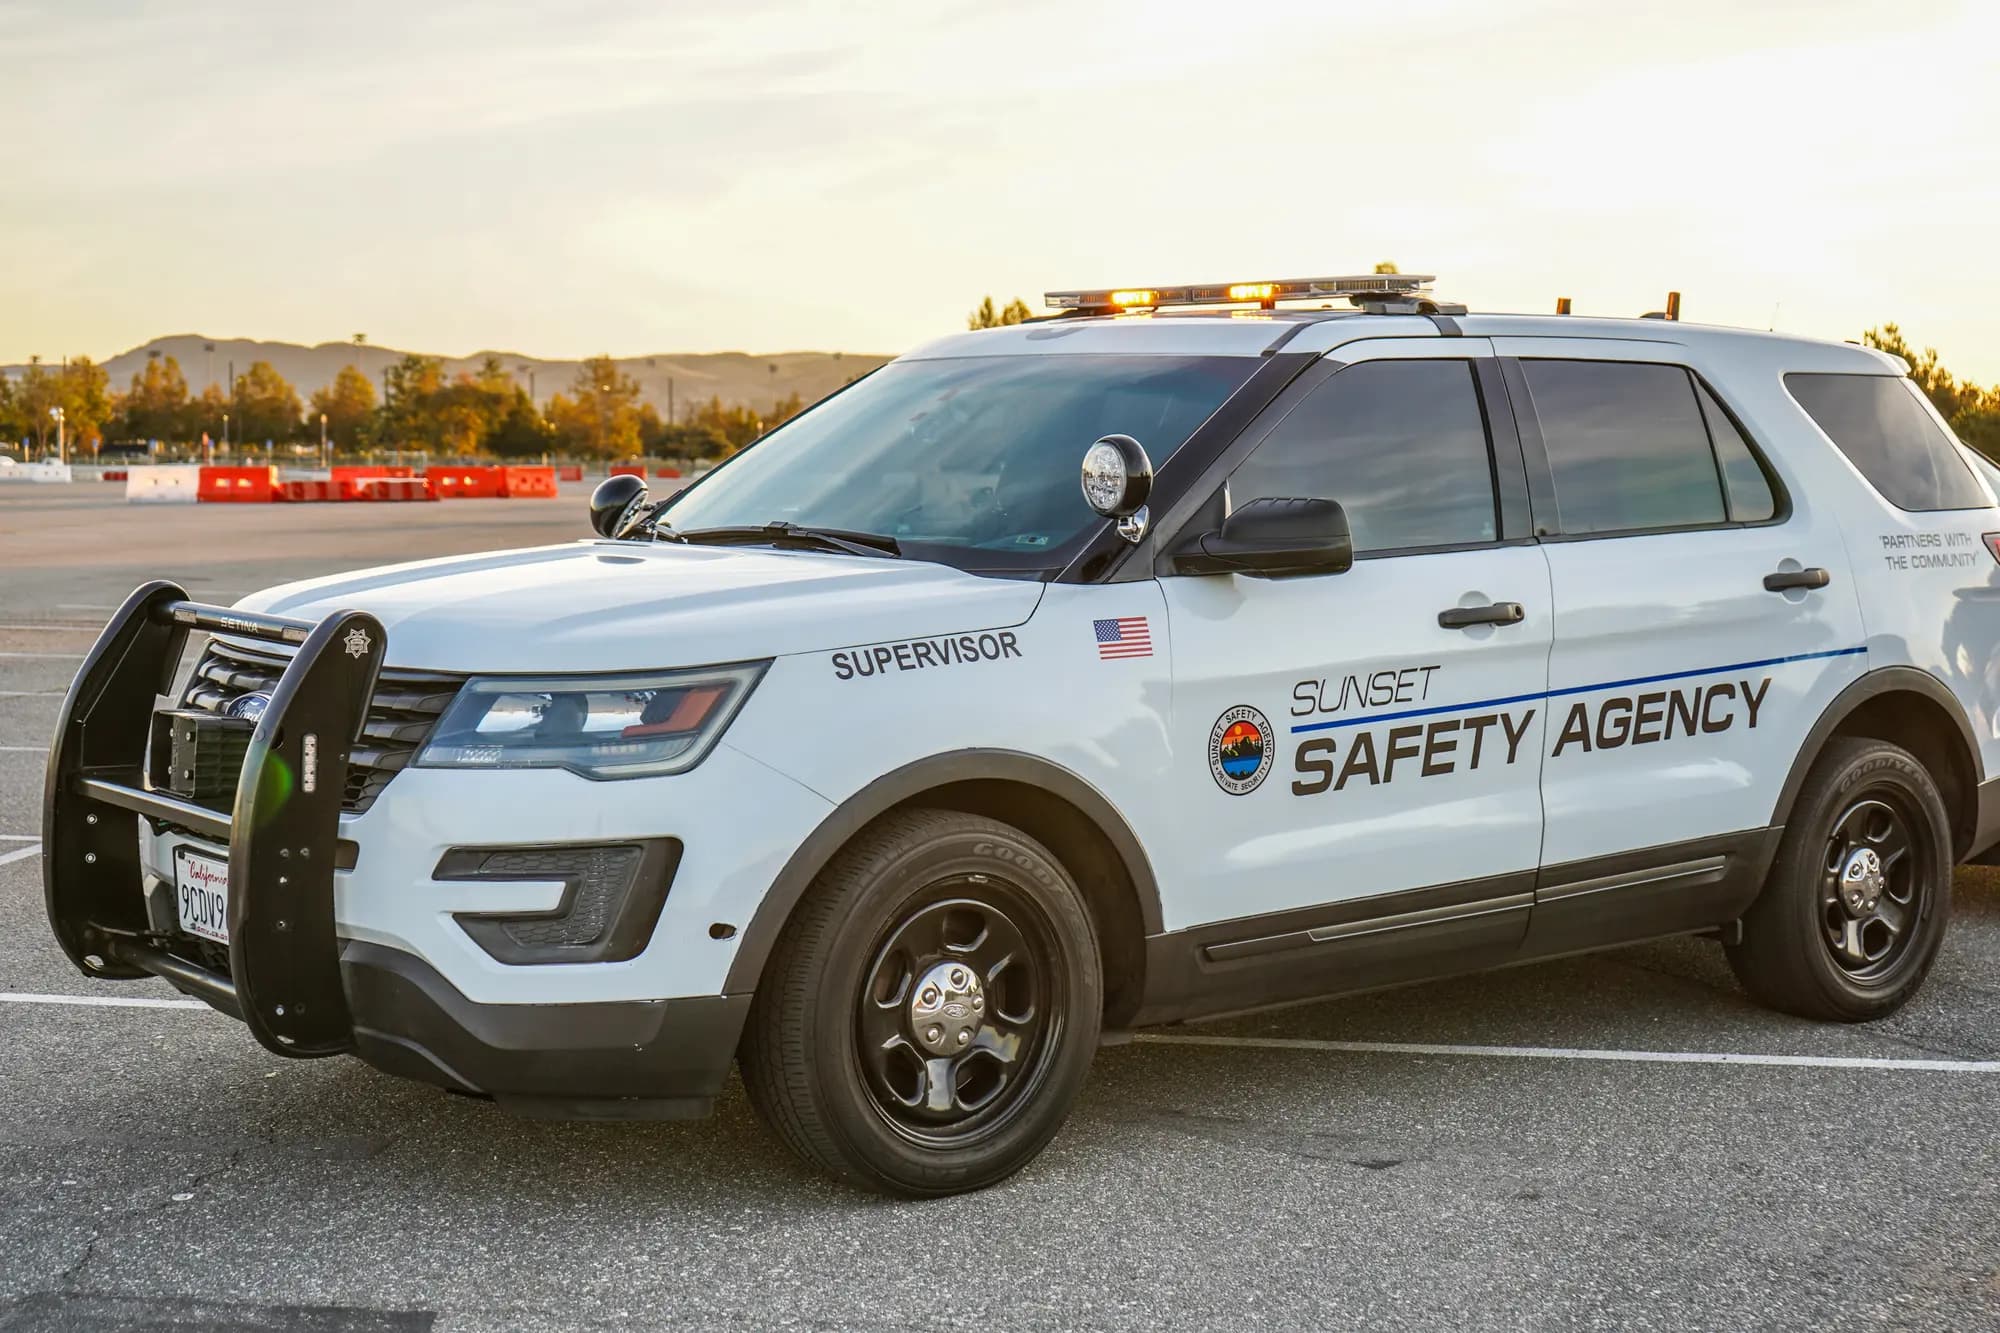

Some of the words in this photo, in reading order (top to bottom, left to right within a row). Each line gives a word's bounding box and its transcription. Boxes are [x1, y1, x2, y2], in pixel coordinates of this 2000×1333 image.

[1944, 533, 1972, 546] WITH
[1885, 555, 1909, 570] THE
[220, 616, 258, 634] SETINA
[831, 632, 1022, 680] SUPERVISOR
[1290, 665, 1441, 716] SUNSET
[1211, 723, 1224, 766] SUNSET
[1225, 709, 1257, 723] SAFETY
[1258, 720, 1272, 761] AGENCY
[1291, 709, 1536, 796] SAFETY
[1552, 678, 1772, 757] AGENCY
[1216, 770, 1239, 791] PRIVATE
[1240, 765, 1266, 791] SECURITY
[182, 884, 224, 929] 9CDV9
